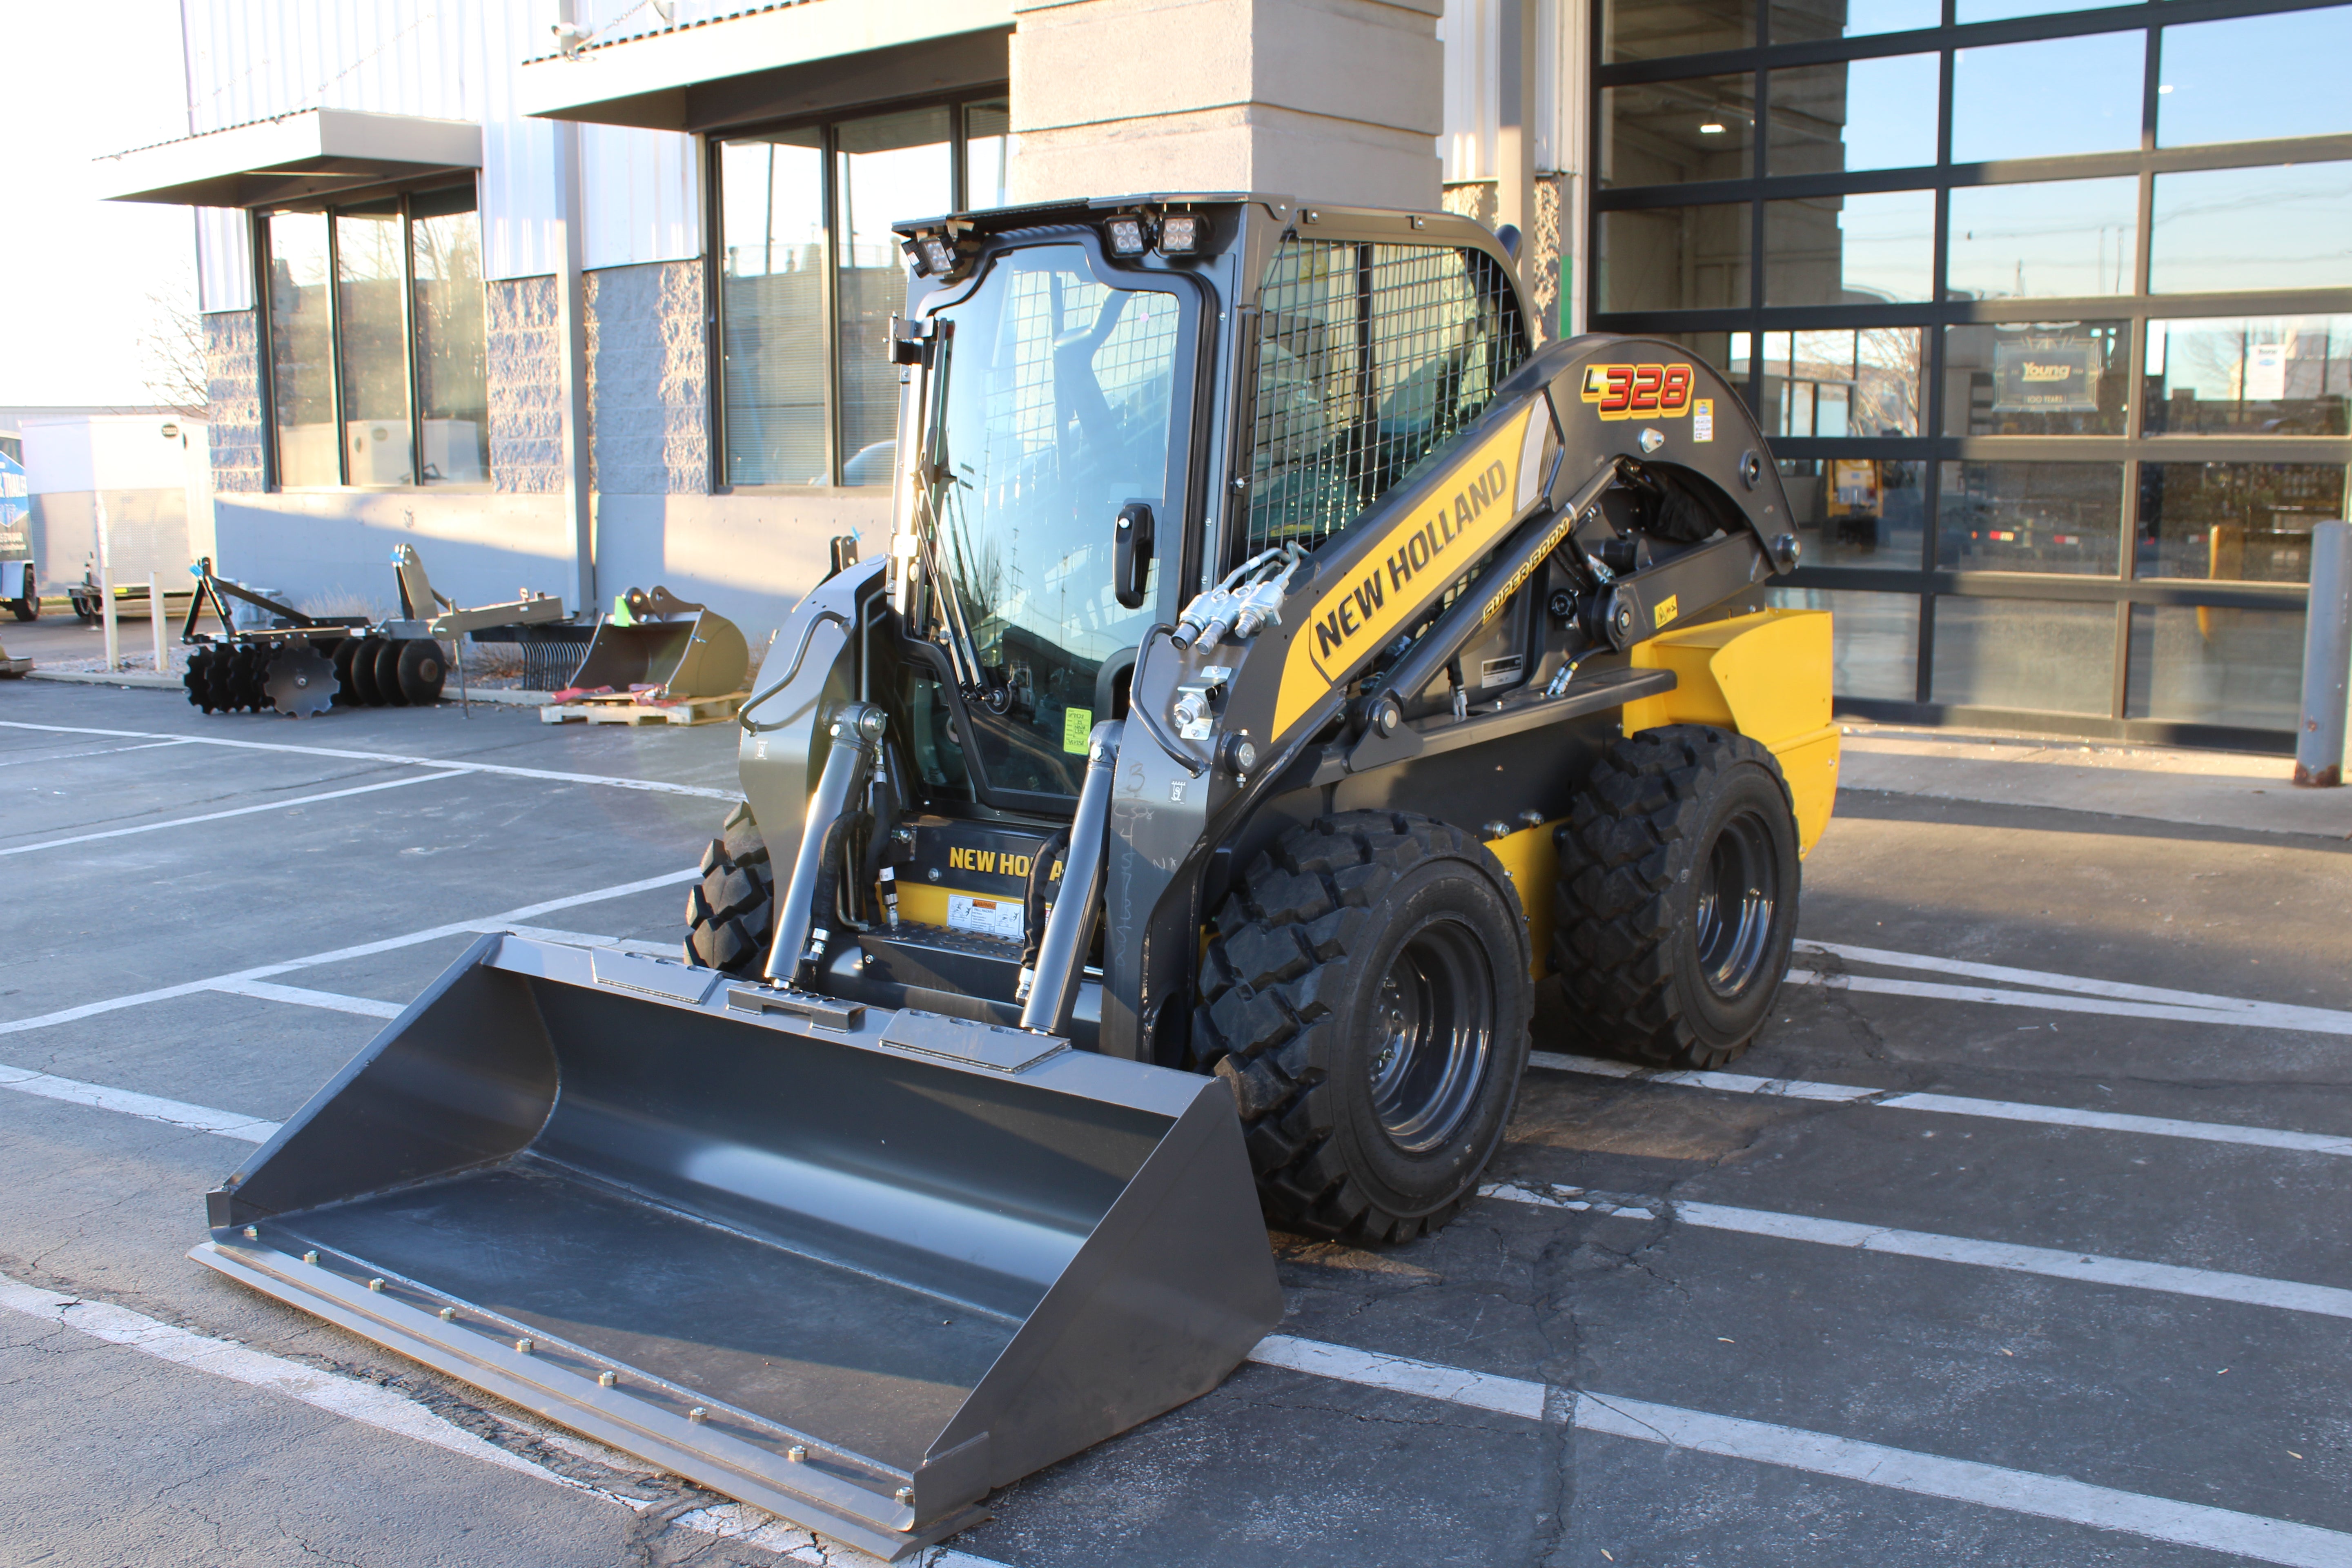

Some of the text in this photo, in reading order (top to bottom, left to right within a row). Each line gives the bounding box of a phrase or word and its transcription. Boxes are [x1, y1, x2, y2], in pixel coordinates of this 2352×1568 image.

[1581, 365, 1693, 417] L328
[2022, 361, 2071, 382] Young
[2027, 395, 2063, 404] 100 YEARS
[1315, 459, 1507, 660] NEW HOLLAND
[1483, 561, 1530, 624] SUPER
[1530, 517, 1570, 572] BOOM
[949, 846, 996, 873] NEW
